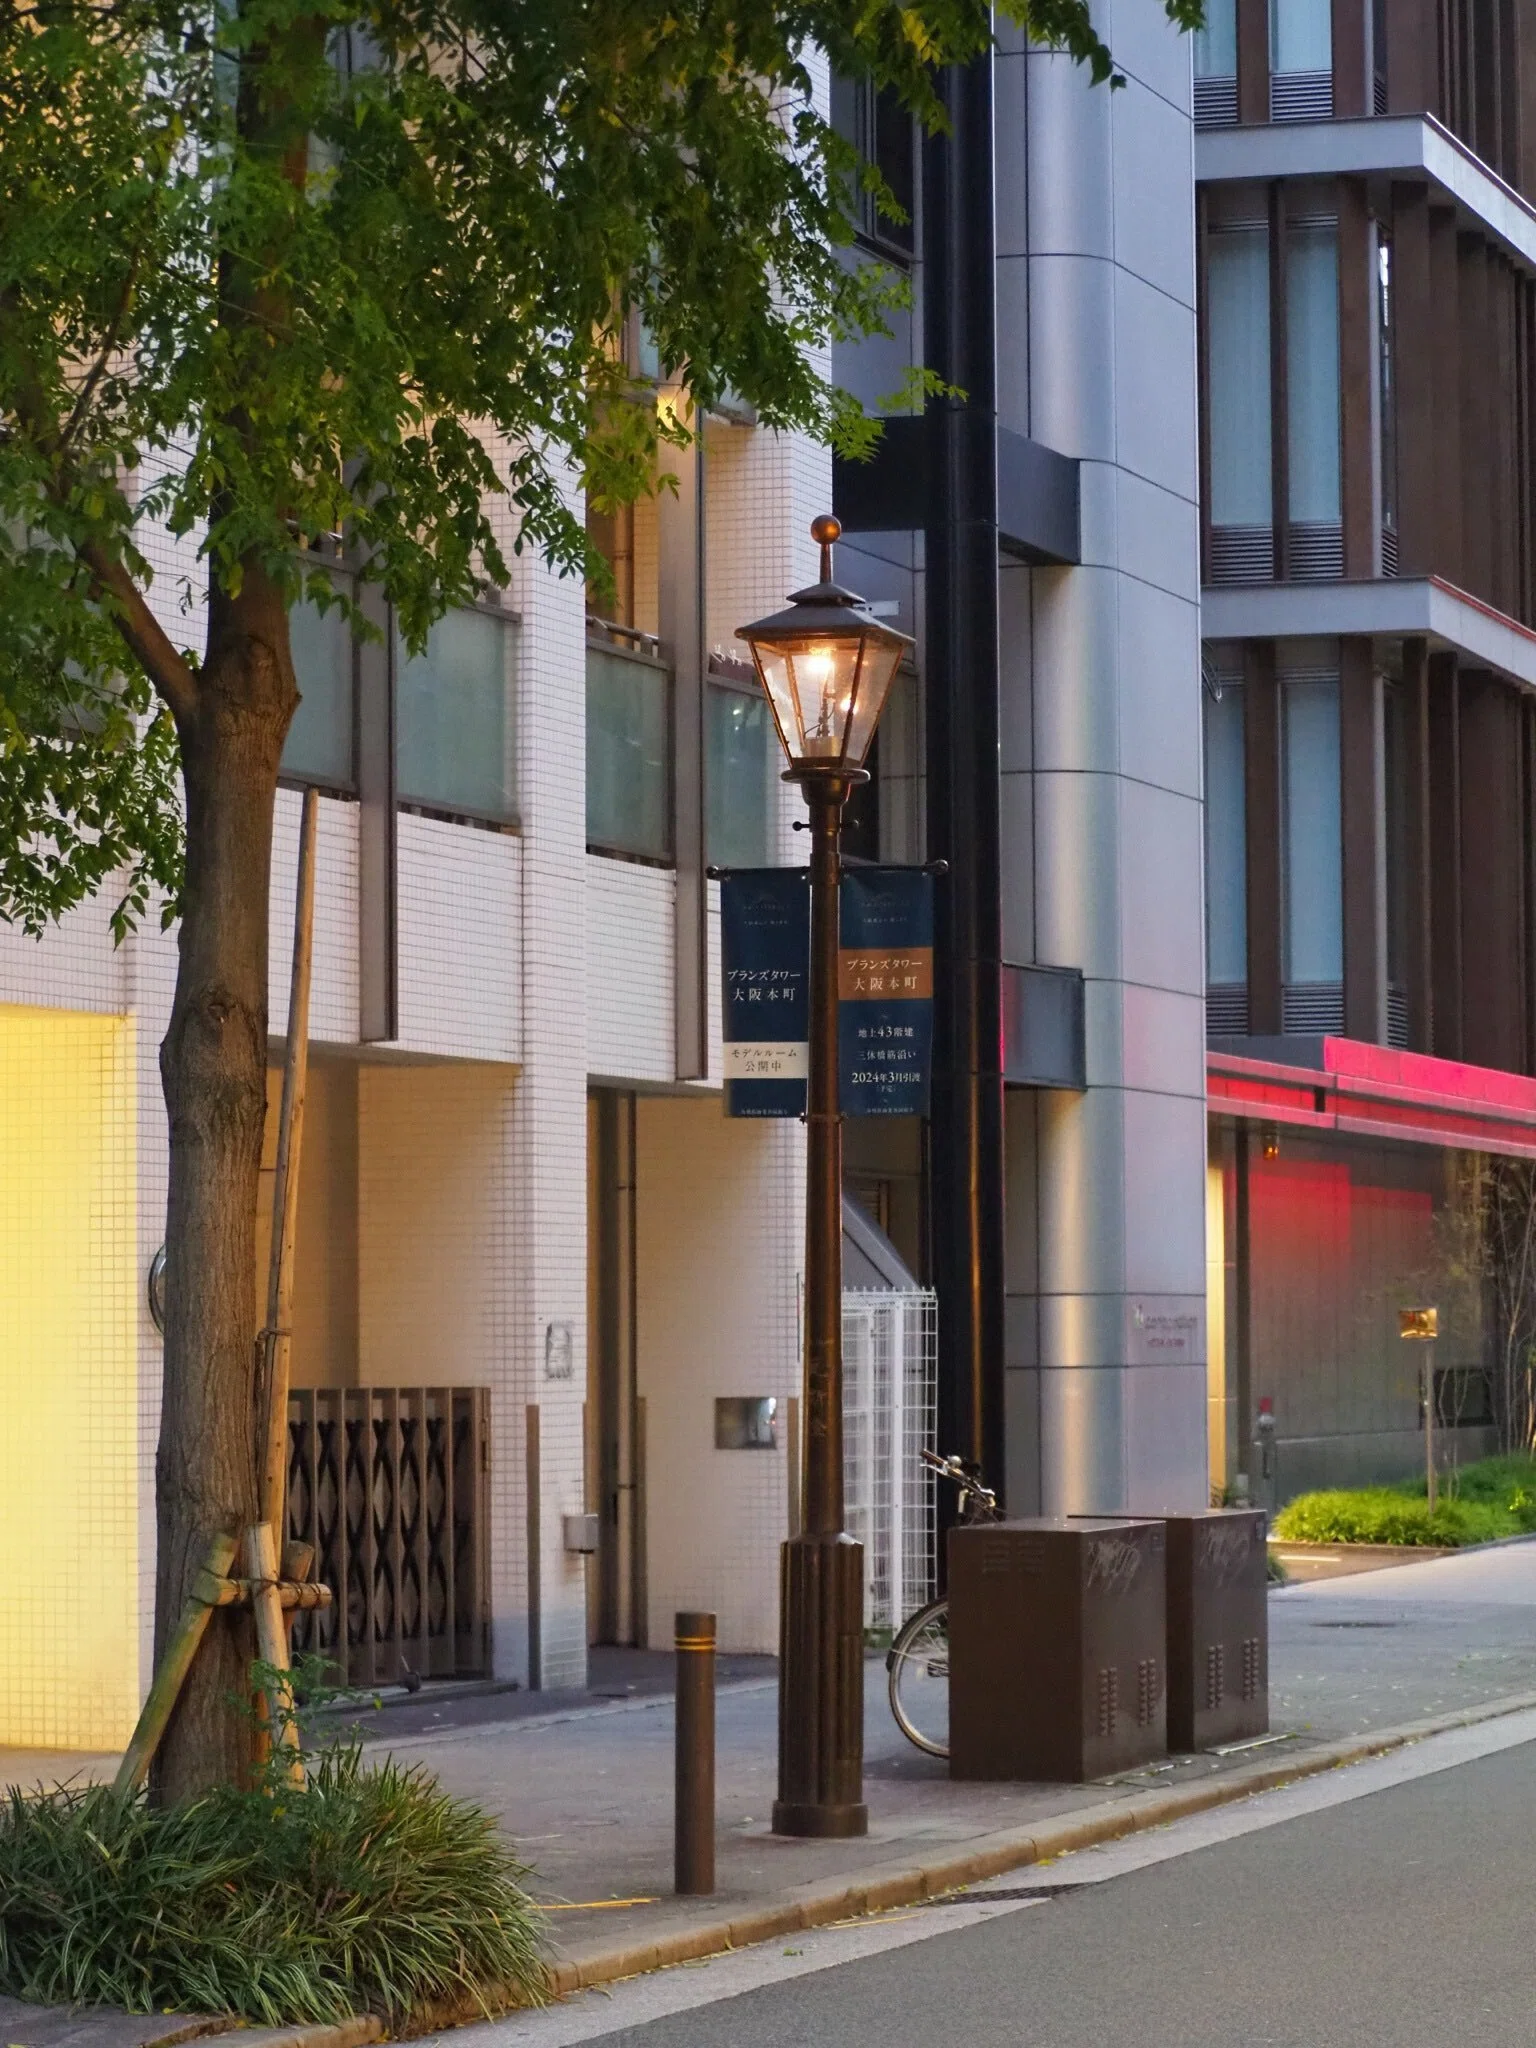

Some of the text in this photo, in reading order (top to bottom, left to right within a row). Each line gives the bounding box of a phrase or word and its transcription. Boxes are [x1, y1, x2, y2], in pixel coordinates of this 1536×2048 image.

[847, 958, 922, 971] ブランズタワー
[727, 970, 801, 981] ブランズタワー
[853, 976, 918, 991] 大阪本町
[733, 988, 796, 1001] 大阪本町
[858, 1026, 914, 1038] 地上43階建
[732, 1048, 797, 1058] モデルルーム
[745, 1060, 781, 1073] 公開中
[852, 1072, 921, 1083] 2024年3月引渡
